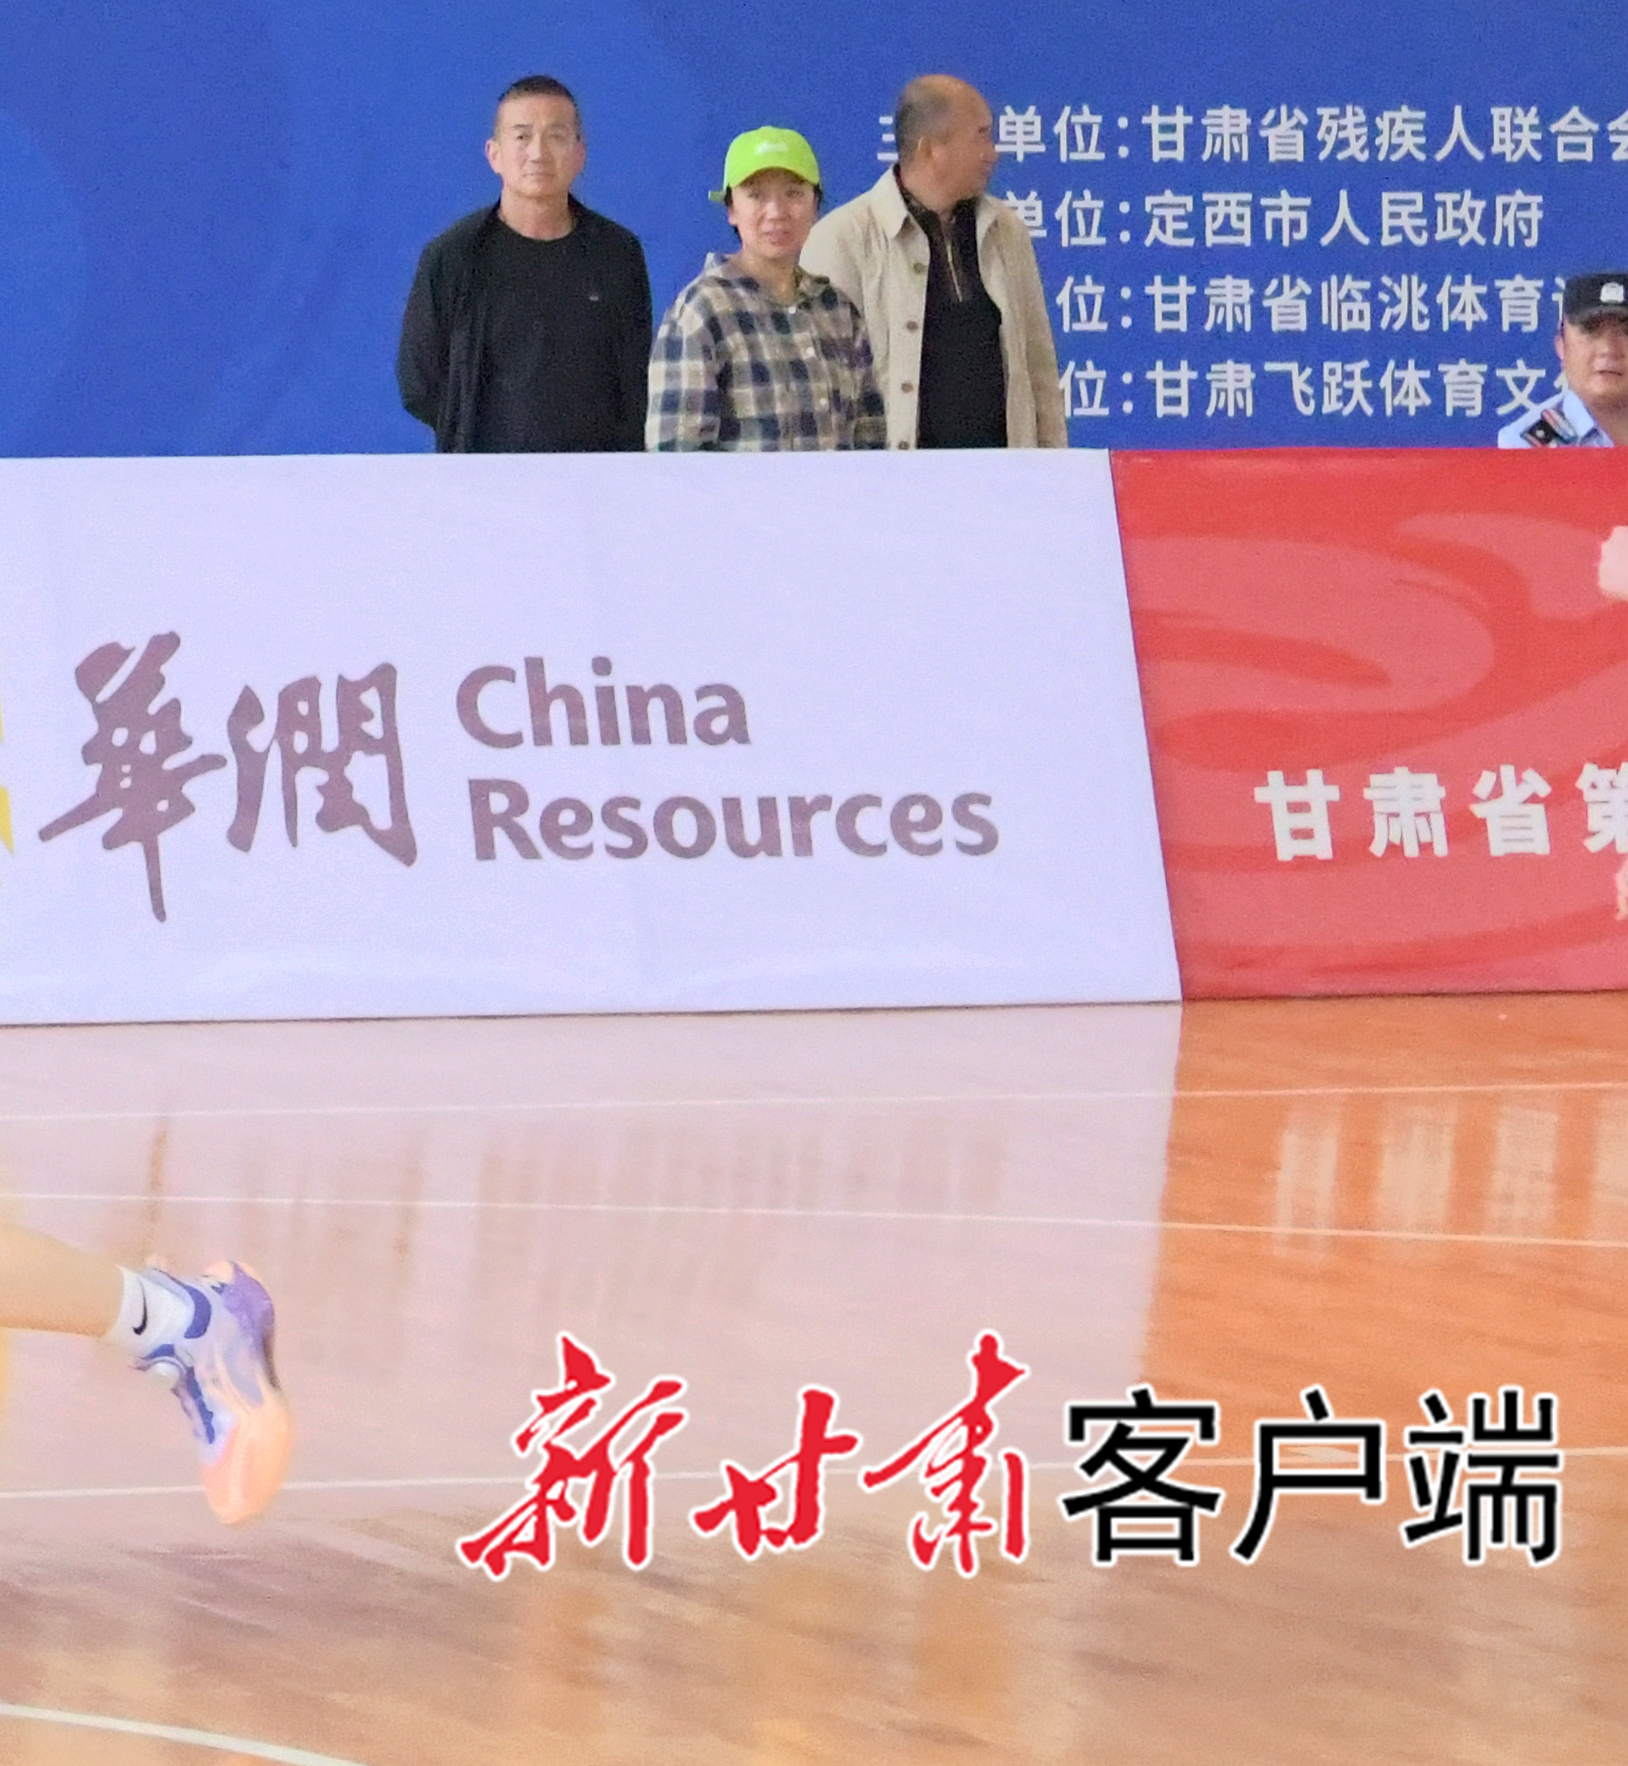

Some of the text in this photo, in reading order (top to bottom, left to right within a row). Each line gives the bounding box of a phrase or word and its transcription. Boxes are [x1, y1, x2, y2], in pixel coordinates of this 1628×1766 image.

[877, 104, 1628, 163] 单位:甘肃省残疾人联合
[1055, 274, 1565, 333] 位:甘肃省临洮体育
[1058, 358, 1567, 418] 位:甘肃飞跃体育文
[456, 655, 751, 749] China
[467, 778, 999, 861] Resources
[1253, 761, 1628, 862] 甘肃省第
